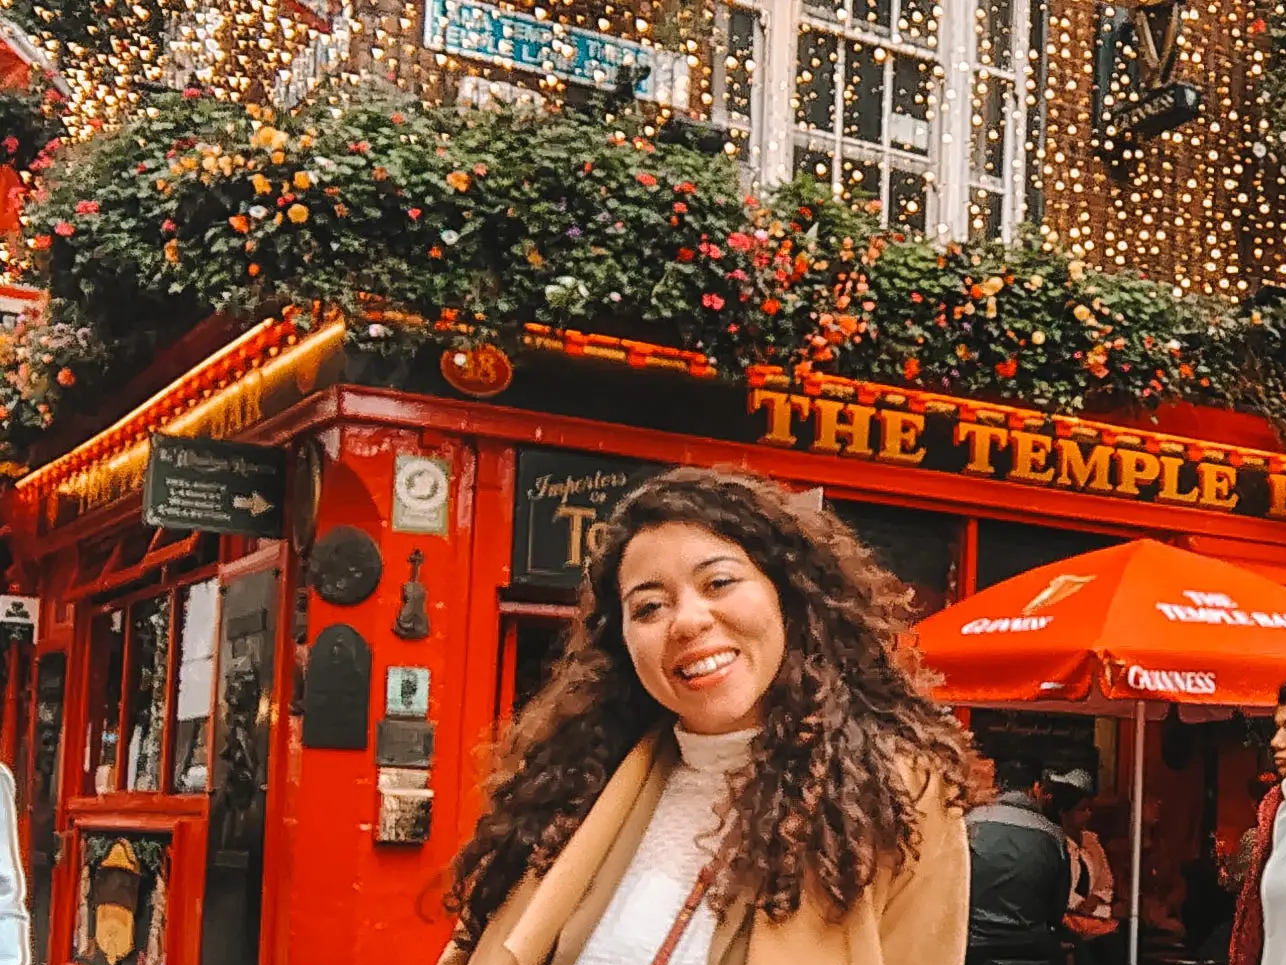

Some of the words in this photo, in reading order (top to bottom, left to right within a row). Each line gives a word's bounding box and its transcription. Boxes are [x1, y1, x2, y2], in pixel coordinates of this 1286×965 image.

[748, 387, 928, 464] THE
[953, 420, 1240, 515] TEMPLE
[1127, 664, 1217, 695] GUINNESS
